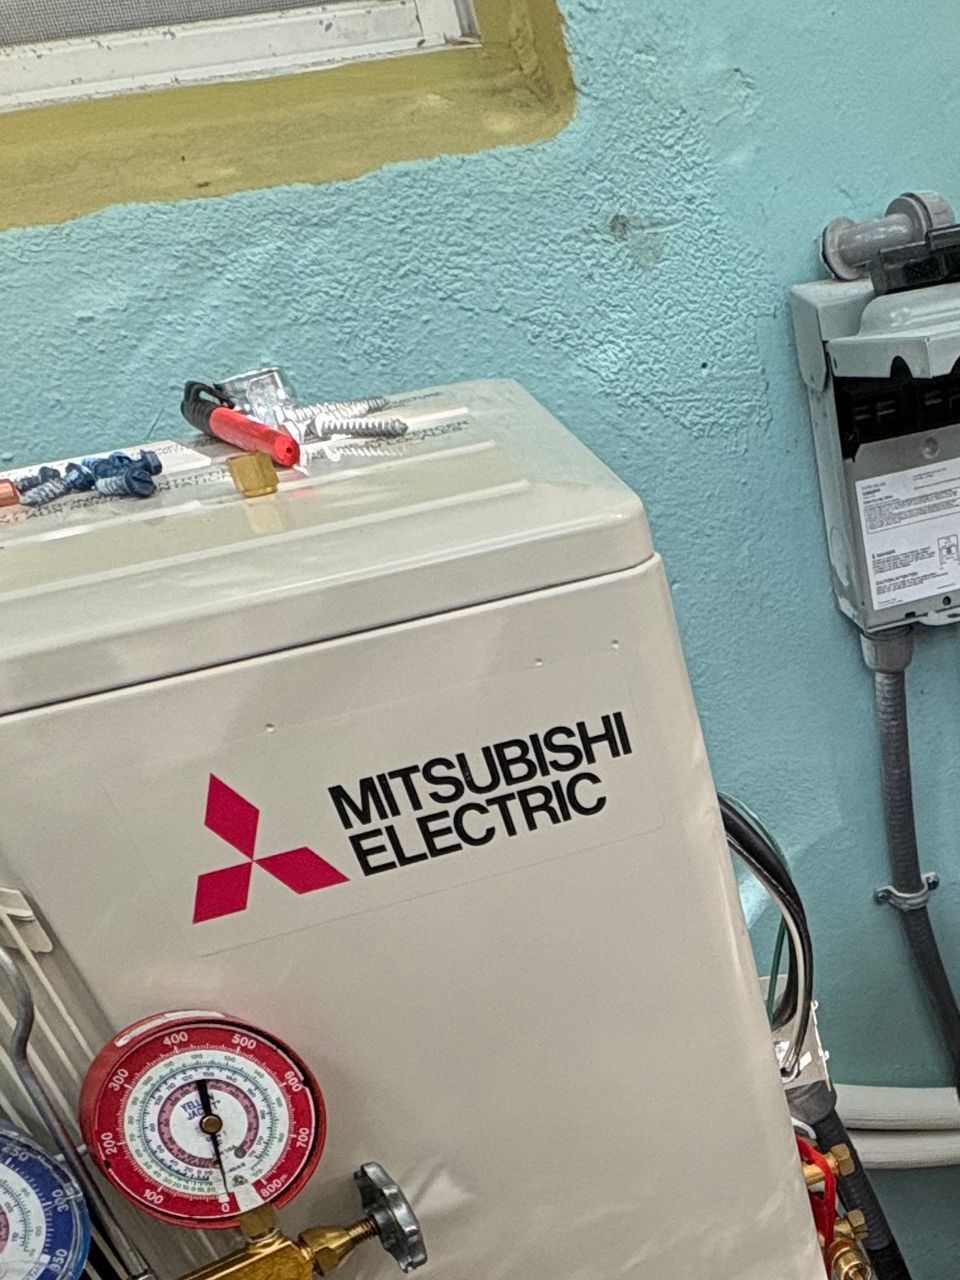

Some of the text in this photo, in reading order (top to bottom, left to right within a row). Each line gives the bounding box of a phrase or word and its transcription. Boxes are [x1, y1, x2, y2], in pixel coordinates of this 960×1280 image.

[328, 711, 633, 829] MITSUBISHI
[349, 772, 607, 876] ELECTRIC
[163, 1031, 188, 1046] 400
[231, 1033, 257, 1050] 500
[108, 1068, 129, 1092] 300
[284, 1070, 303, 1093] 600
[187, 1101, 218, 1121] JACT
[100, 1131, 117, 1155] 200
[297, 1127, 309, 1149] 700
[142, 1188, 165, 1206] 100
[260, 1178, 282, 1198] 800
[51, 1188, 70, 1214] 300
[222, 1202, 230, 1213] 0
